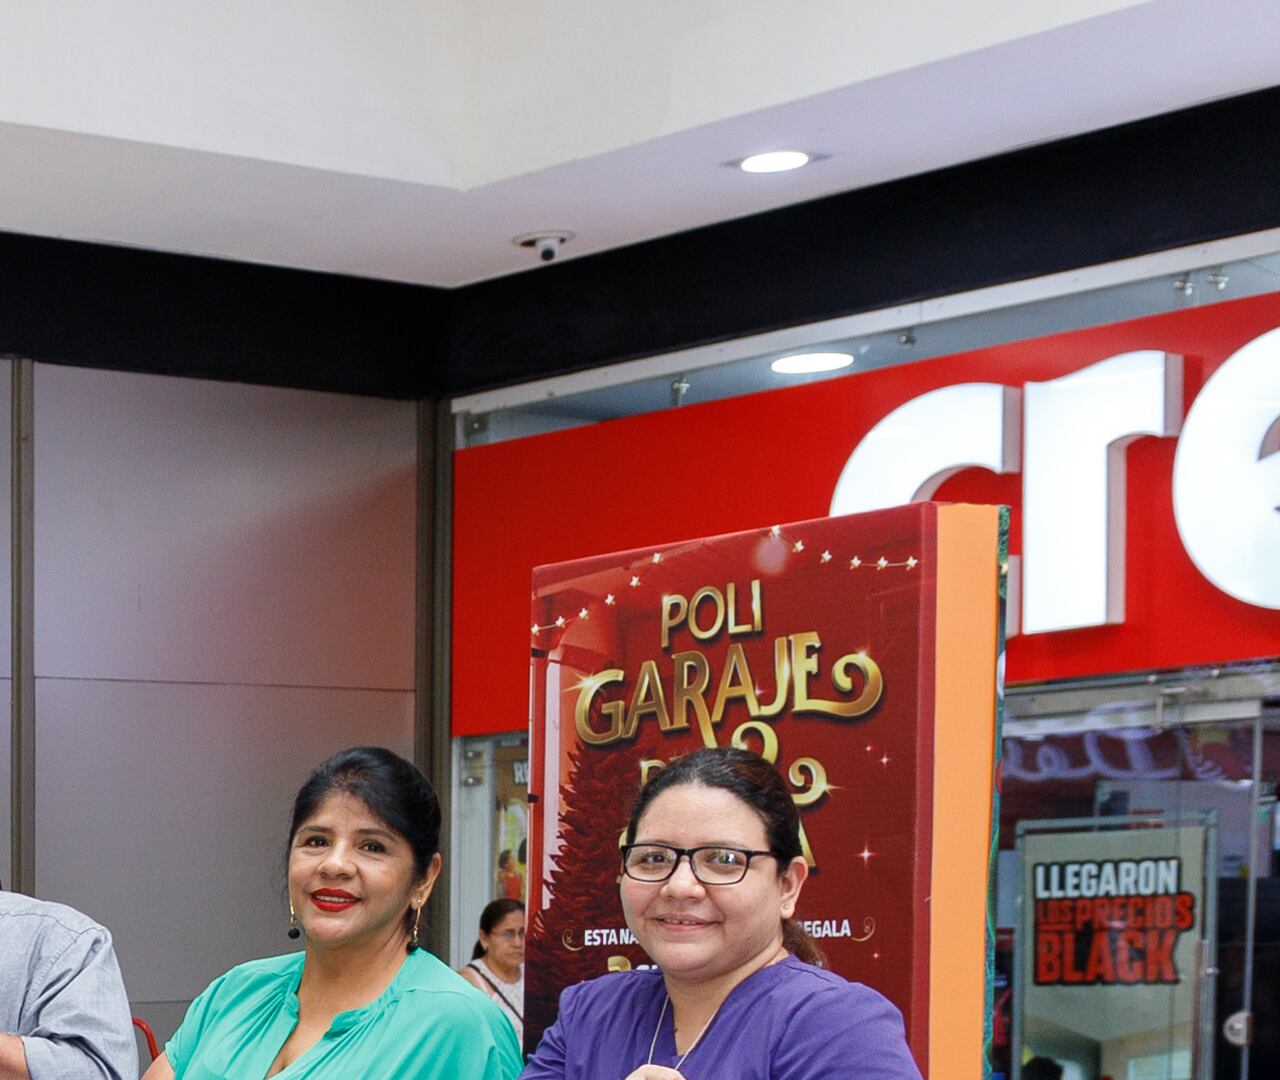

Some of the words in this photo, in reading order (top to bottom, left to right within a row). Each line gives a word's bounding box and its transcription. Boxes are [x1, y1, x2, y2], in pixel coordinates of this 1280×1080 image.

[661, 579, 763, 649] POLI
[574, 631, 883, 752] GARAJE
[1035, 859, 1179, 898] LLEGARON
[1075, 893, 1194, 930] PRECIOS
[584, 929, 618, 946] ESTA
[619, 928, 640, 945] NA
[1035, 929, 1178, 982] BLACK
